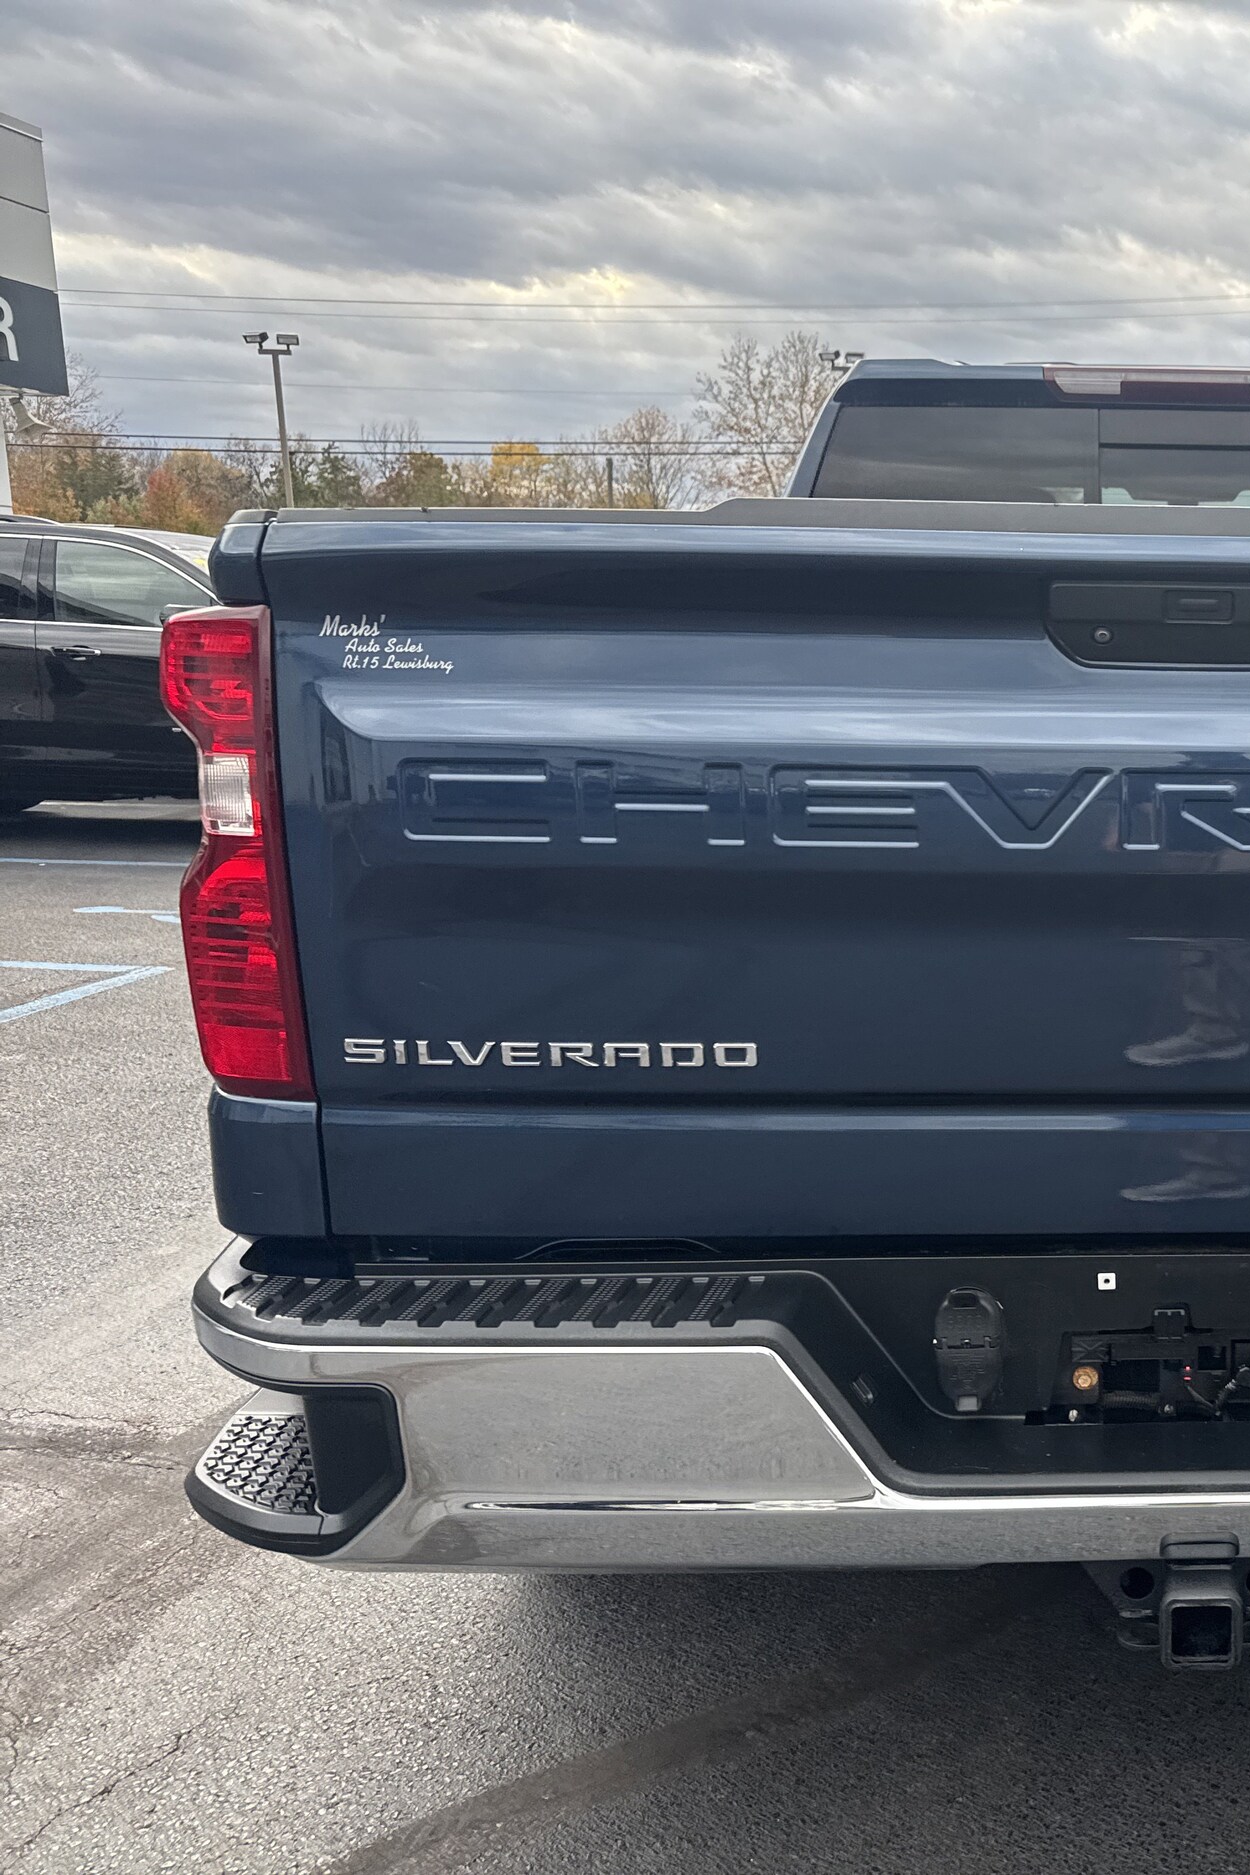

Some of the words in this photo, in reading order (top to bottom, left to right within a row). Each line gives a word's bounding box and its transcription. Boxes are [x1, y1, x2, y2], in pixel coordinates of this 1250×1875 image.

[319, 614, 386, 637] Marks'
[344, 637, 380, 653] Auto
[384, 637, 424, 653] Sales
[382, 654, 454, 674] Lewisburg
[344, 1037, 758, 1068] SILVERADO
